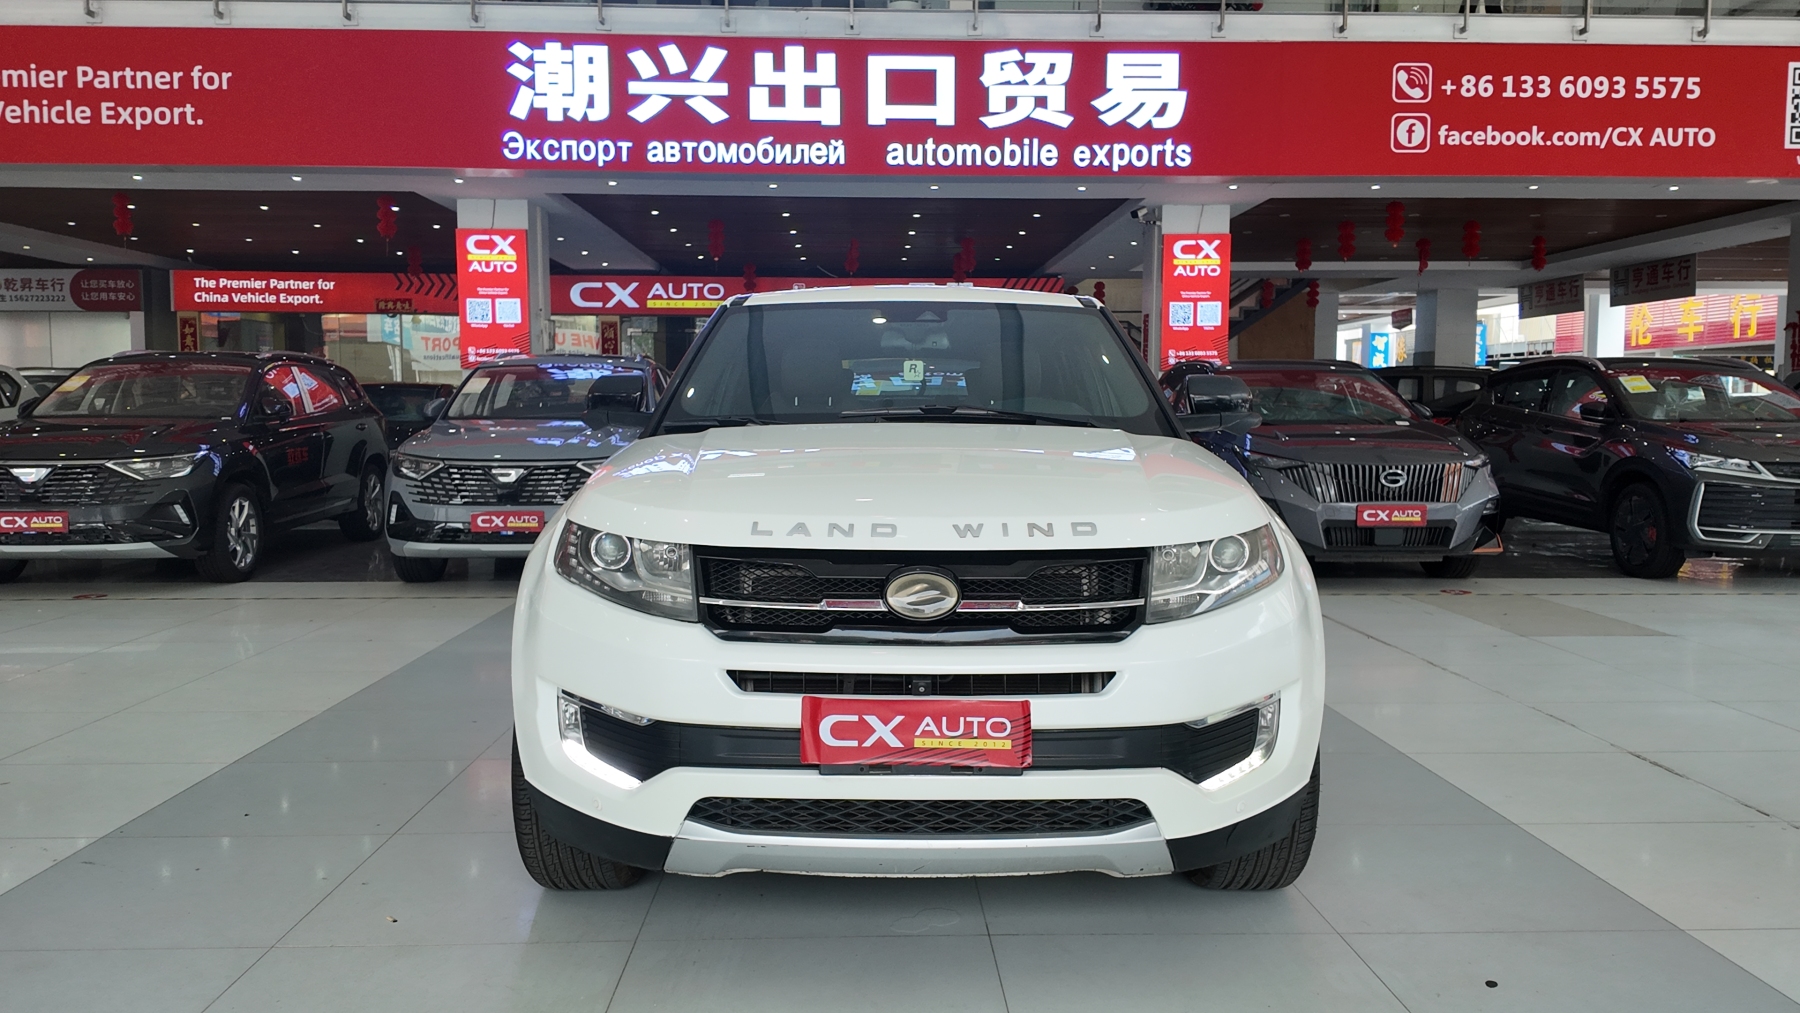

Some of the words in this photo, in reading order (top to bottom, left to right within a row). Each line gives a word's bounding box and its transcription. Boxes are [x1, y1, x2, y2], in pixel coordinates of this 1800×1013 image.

[77, 66, 183, 90] Partner
[191, 65, 232, 90] for
[506, 42, 1188, 129] 潮兴出口贸易
[1441, 75, 1494, 98] +86
[1502, 75, 1551, 98] 133
[1559, 76, 1626, 99] 6093
[1635, 77, 1701, 99] 5575
[0, 100, 91, 124] ehicle
[101, 102, 204, 130] Export.
[1438, 124, 1643, 149] facebook.com/CX
[1649, 127, 1716, 147] AUTO
[502, 131, 633, 167] Экспорт
[646, 137, 845, 165] автомобилей
[886, 138, 1058, 168] automobile
[1073, 138, 1192, 172] exports
[466, 234, 516, 255] CX
[1173, 240, 1221, 259] CX
[468, 261, 517, 273] AUTO
[1173, 265, 1221, 277] AUTO
[1632, 259, 1691, 288] 亨通车行
[194, 277, 216, 288] The
[219, 278, 267, 289] Premier
[270, 279, 315, 290] Partner
[318, 279, 335, 290] for
[194, 292, 229, 303] China
[232, 292, 276, 304] Vehicle
[280, 293, 323, 306] Export.
[570, 282, 640, 308] CX
[647, 283, 725, 299] AUTO
[0, 516, 28, 528] CX
[31, 516, 63, 524] AUTO
[477, 515, 505, 527] CX
[507, 515, 539, 523] AUTO
[1363, 509, 1390, 521] CX
[1392, 509, 1422, 517] AUTO
[751, 521, 898, 539] LAND
[952, 522, 1098, 539] WIND
[819, 714, 905, 748] CX
[914, 716, 1012, 737] AUTO
